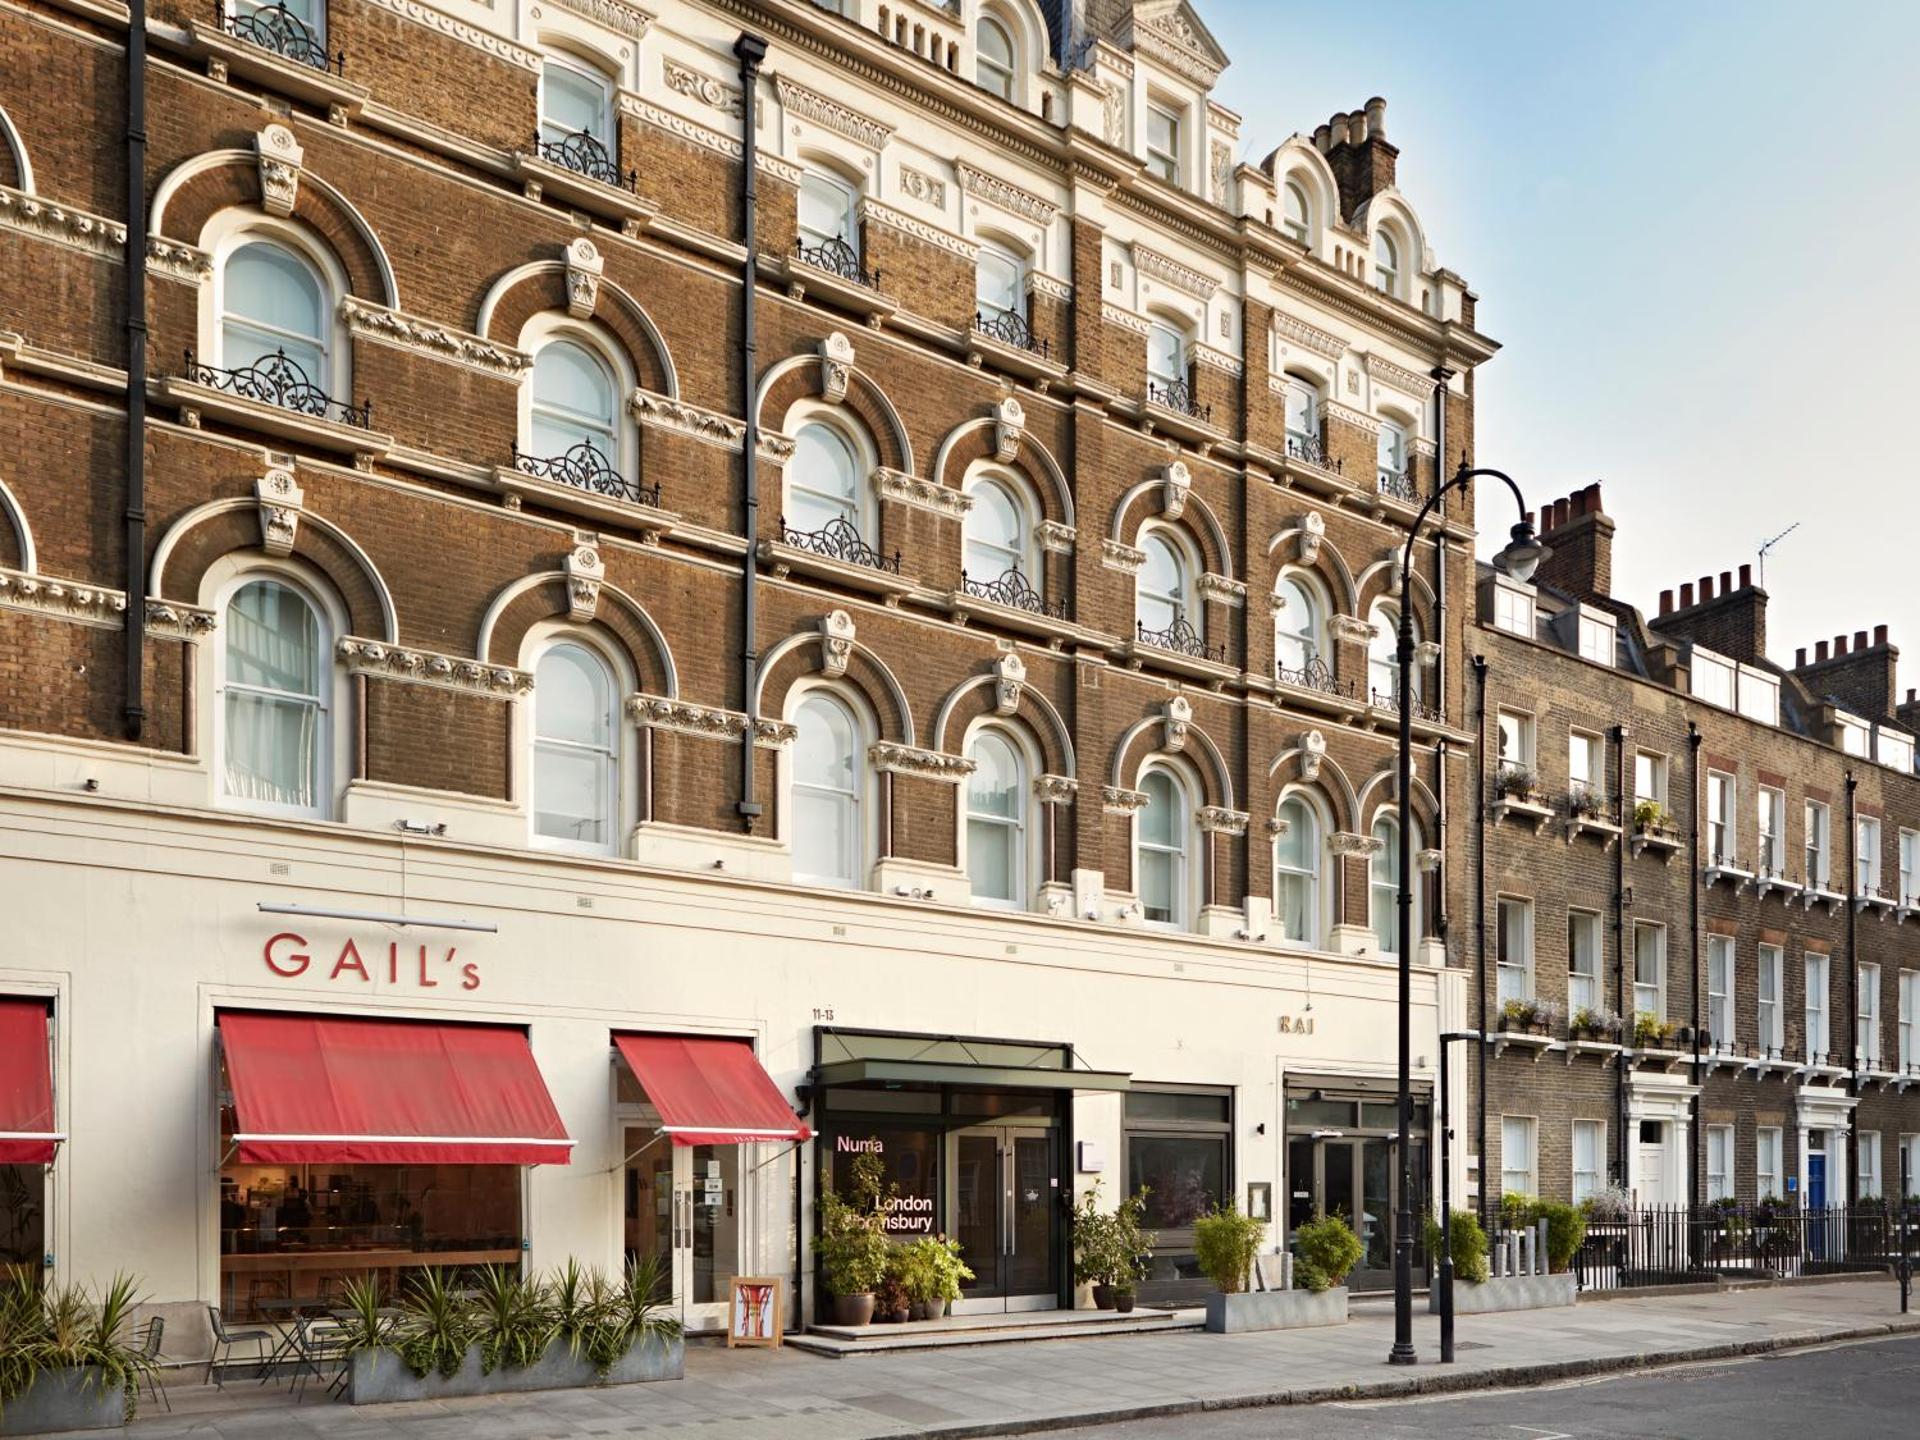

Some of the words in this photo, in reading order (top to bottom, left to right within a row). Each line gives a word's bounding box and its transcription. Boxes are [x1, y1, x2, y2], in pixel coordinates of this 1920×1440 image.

[264, 932, 480, 990] GAIL's
[812, 1008, 834, 1021] 11-13
[837, 1136, 883, 1153] Numa
[875, 1195, 932, 1211] London
